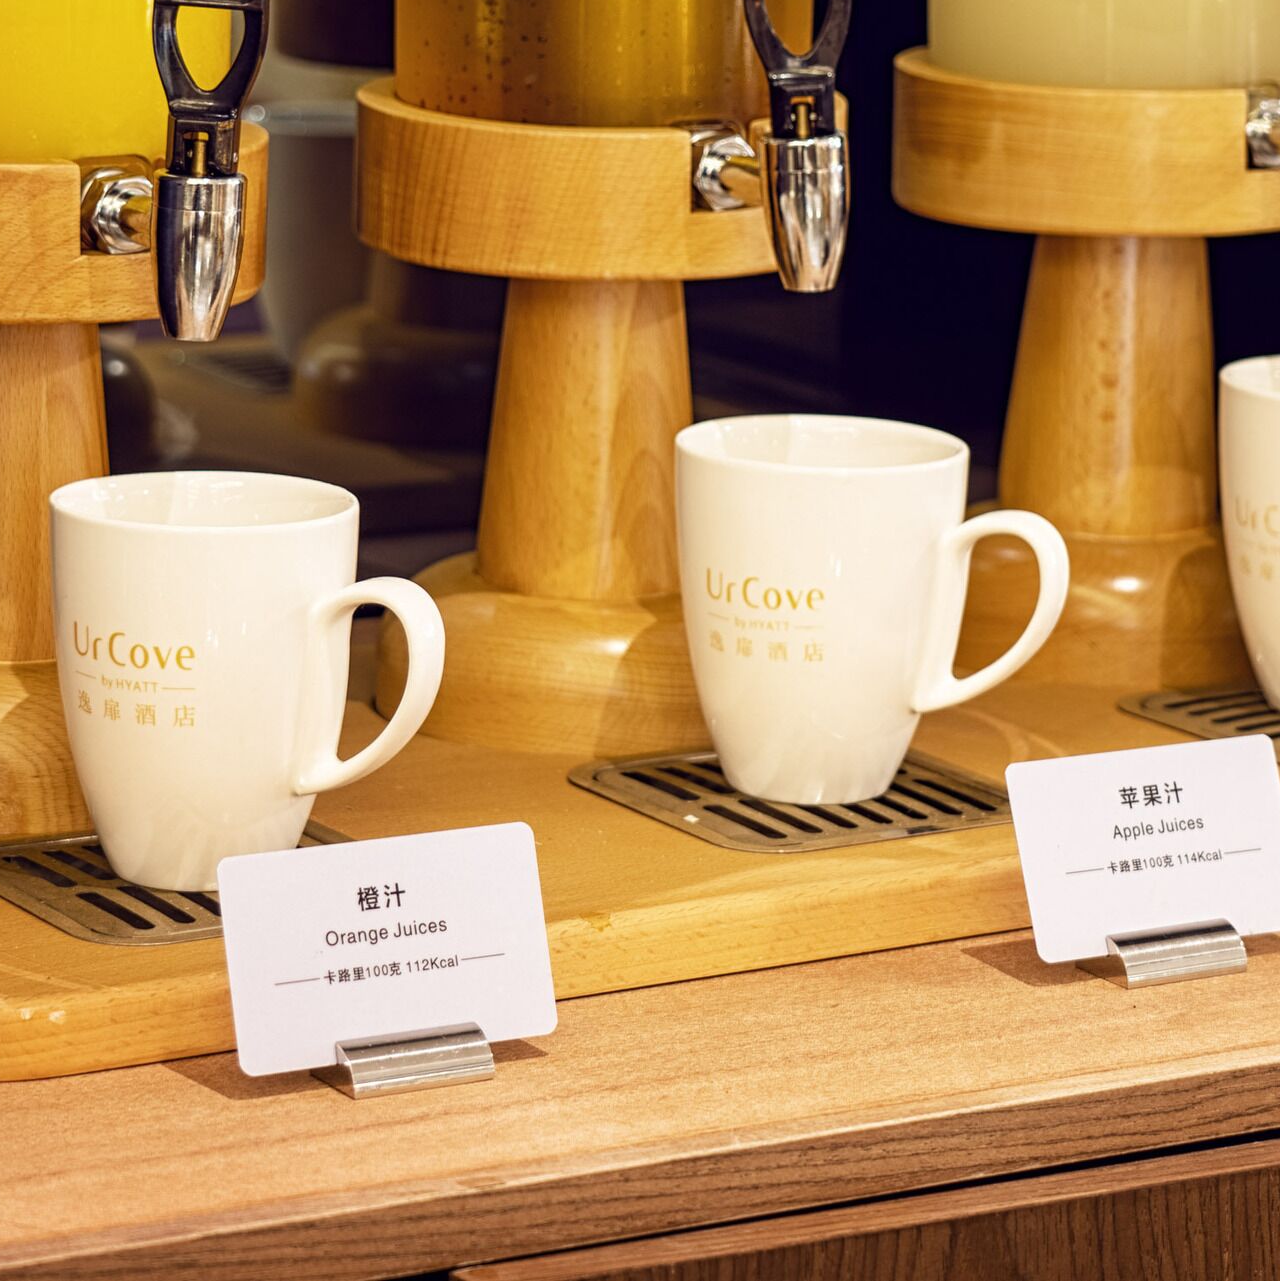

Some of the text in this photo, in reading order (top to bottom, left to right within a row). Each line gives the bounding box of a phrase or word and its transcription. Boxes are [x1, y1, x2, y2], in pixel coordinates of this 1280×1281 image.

[706, 568, 825, 611] UrCove
[73, 620, 195, 671] UrCove
[101, 675, 158, 693] by HYATT
[1119, 781, 1183, 808] 苹果汁
[1113, 818, 1204, 841] Apple Juices
[1108, 850, 1222, 874] 卡路里100克 114Kcal
[357, 883, 405, 911] 橙汁
[326, 920, 447, 946] Orange Juices
[324, 955, 458, 984] 卡路里100克 112Kcal
